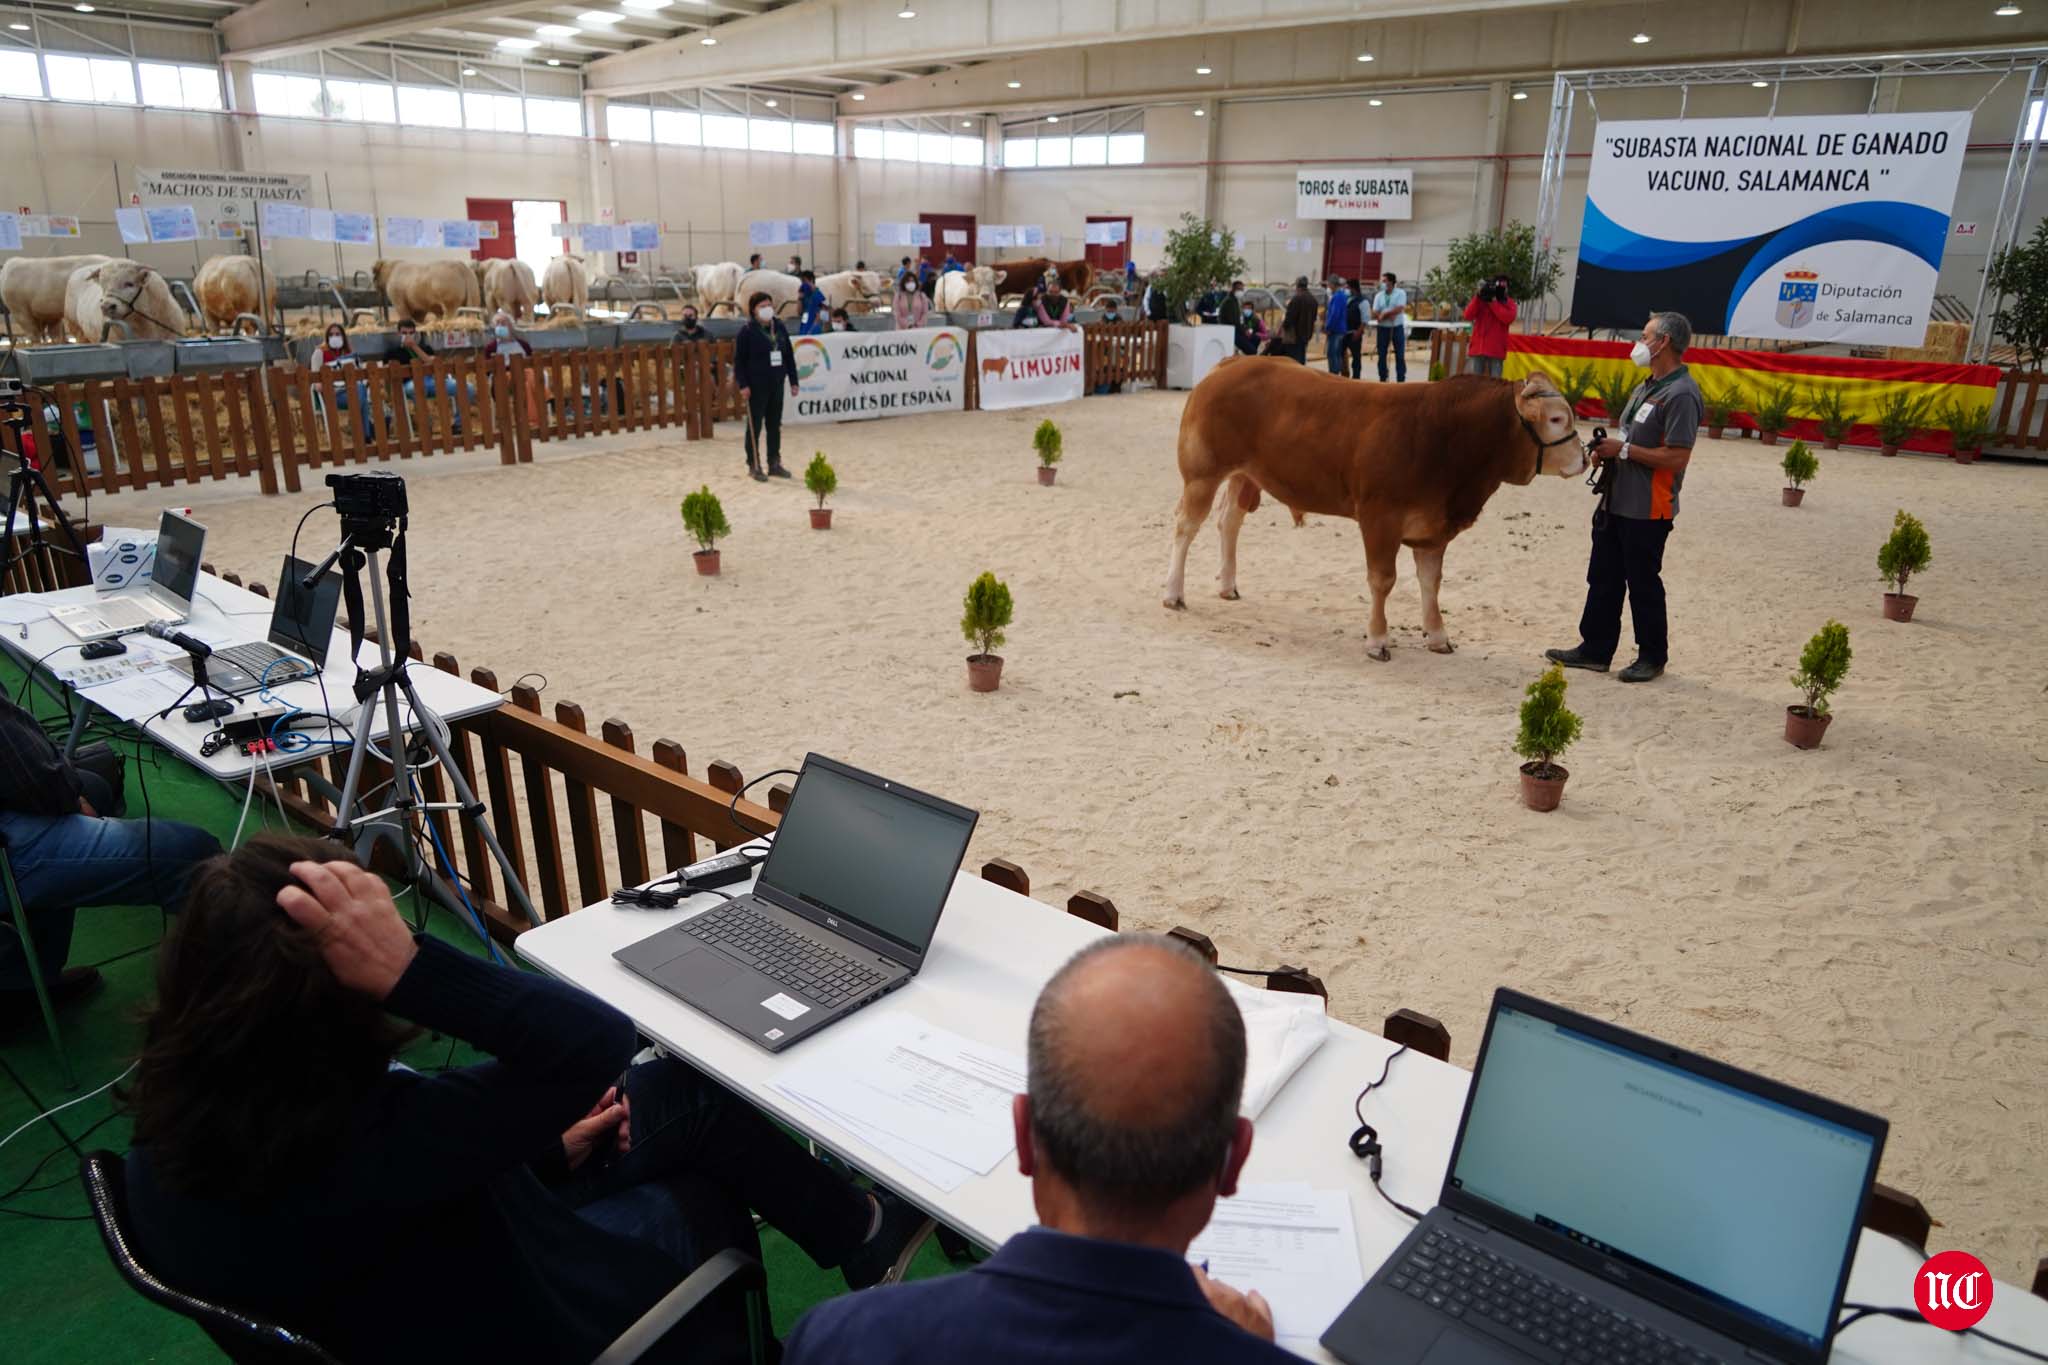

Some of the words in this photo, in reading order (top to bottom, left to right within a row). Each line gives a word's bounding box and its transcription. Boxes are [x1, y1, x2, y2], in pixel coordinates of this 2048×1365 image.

[1605, 136, 1697, 158] "SUBASTA
[1704, 134, 1808, 158] NACIONAL
[1817, 133, 1847, 156] DE
[1852, 130, 1949, 156] GANADO
[217, 185, 239, 198] DE
[1299, 180, 1335, 195] TOROS
[1338, 179, 1352, 195] de
[1355, 179, 1409, 195] SUBASTA
[1821, 283, 1903, 299] Diputación
[1816, 311, 1830, 321] de
[1834, 309, 1913, 325] Salamanca
[842, 341, 917, 360] ASOCIACIÓN
[1010, 353, 1080, 380] LIMUSIN
[850, 369, 908, 384] NACIONAL
[881, 393, 898, 408] DE
[901, 386, 952, 407] ESPAÑA
